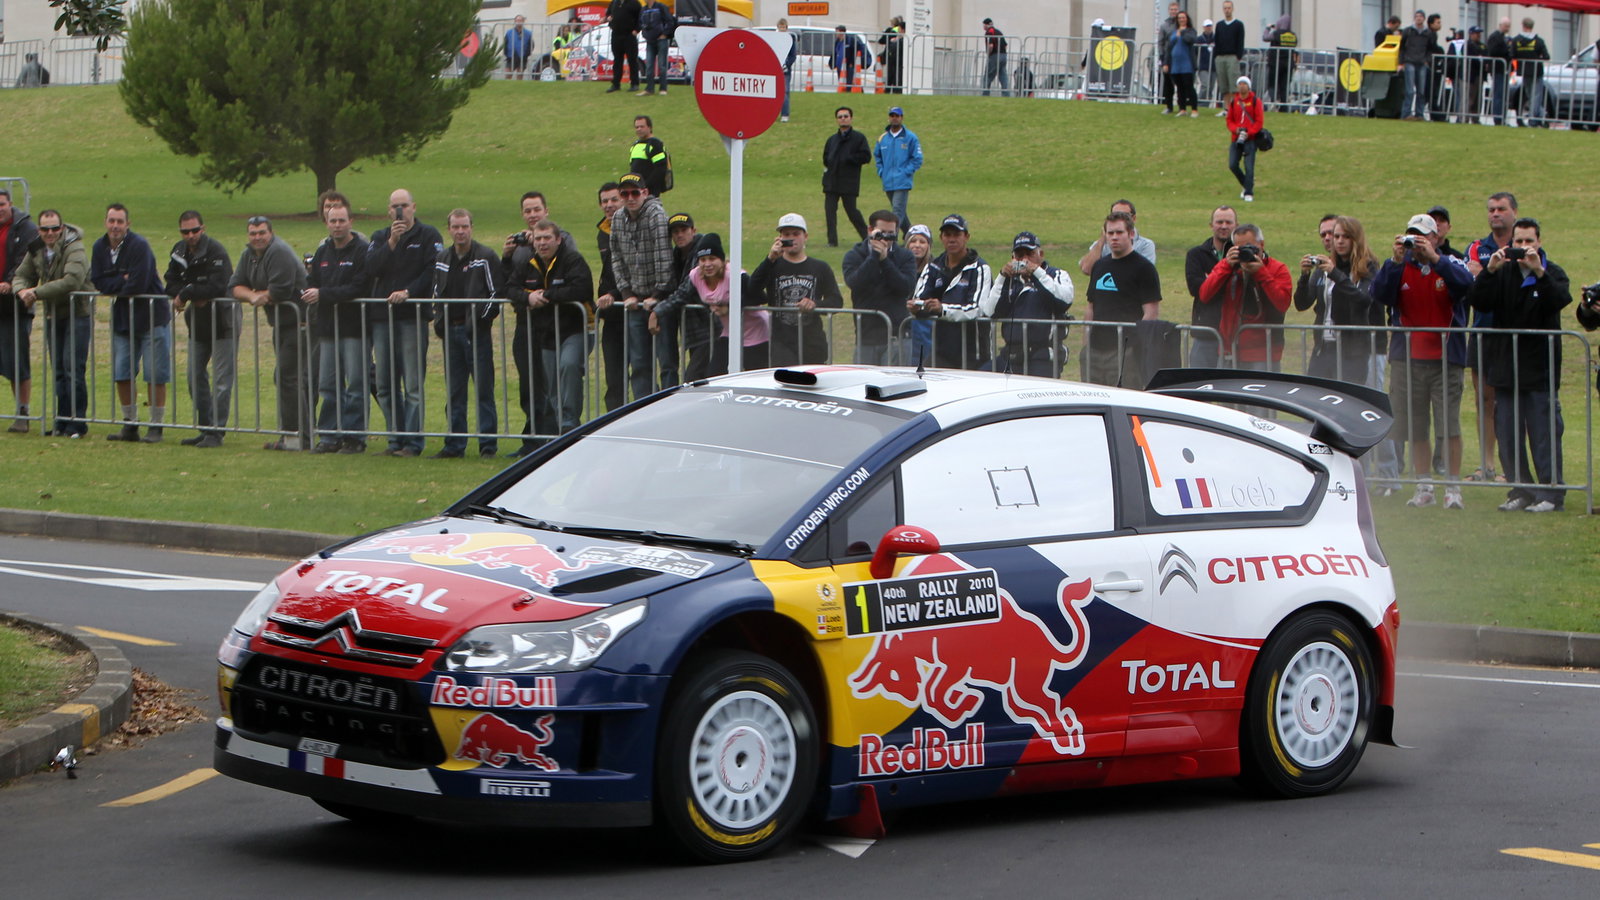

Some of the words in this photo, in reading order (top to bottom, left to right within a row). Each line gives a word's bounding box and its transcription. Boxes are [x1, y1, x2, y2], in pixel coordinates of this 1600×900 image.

[712, 75, 726, 91] NO
[733, 77, 766, 94] ENTRY
[1131, 415, 1162, 488] 1
[785, 466, 871, 550] CITROEN-WRC.COM
[1211, 476, 1277, 508] Loeb
[580, 553, 620, 561] NEW
[315, 570, 449, 614] TOTAL
[883, 586, 907, 600] 40th
[918, 578, 958, 598] RALLY
[969, 576, 993, 590] 2010
[826, 615, 841, 623] Loeb
[855, 585, 870, 633] 1
[884, 601, 921, 624] NEW
[925, 593, 997, 620] ZEALAND
[431, 675, 492, 707] Red
[493, 676, 557, 708] Bull
[1121, 659, 1236, 694] TOTAL
[859, 727, 923, 776] Red
[925, 722, 985, 771] Bull
[480, 778, 551, 797] PIRELLI
